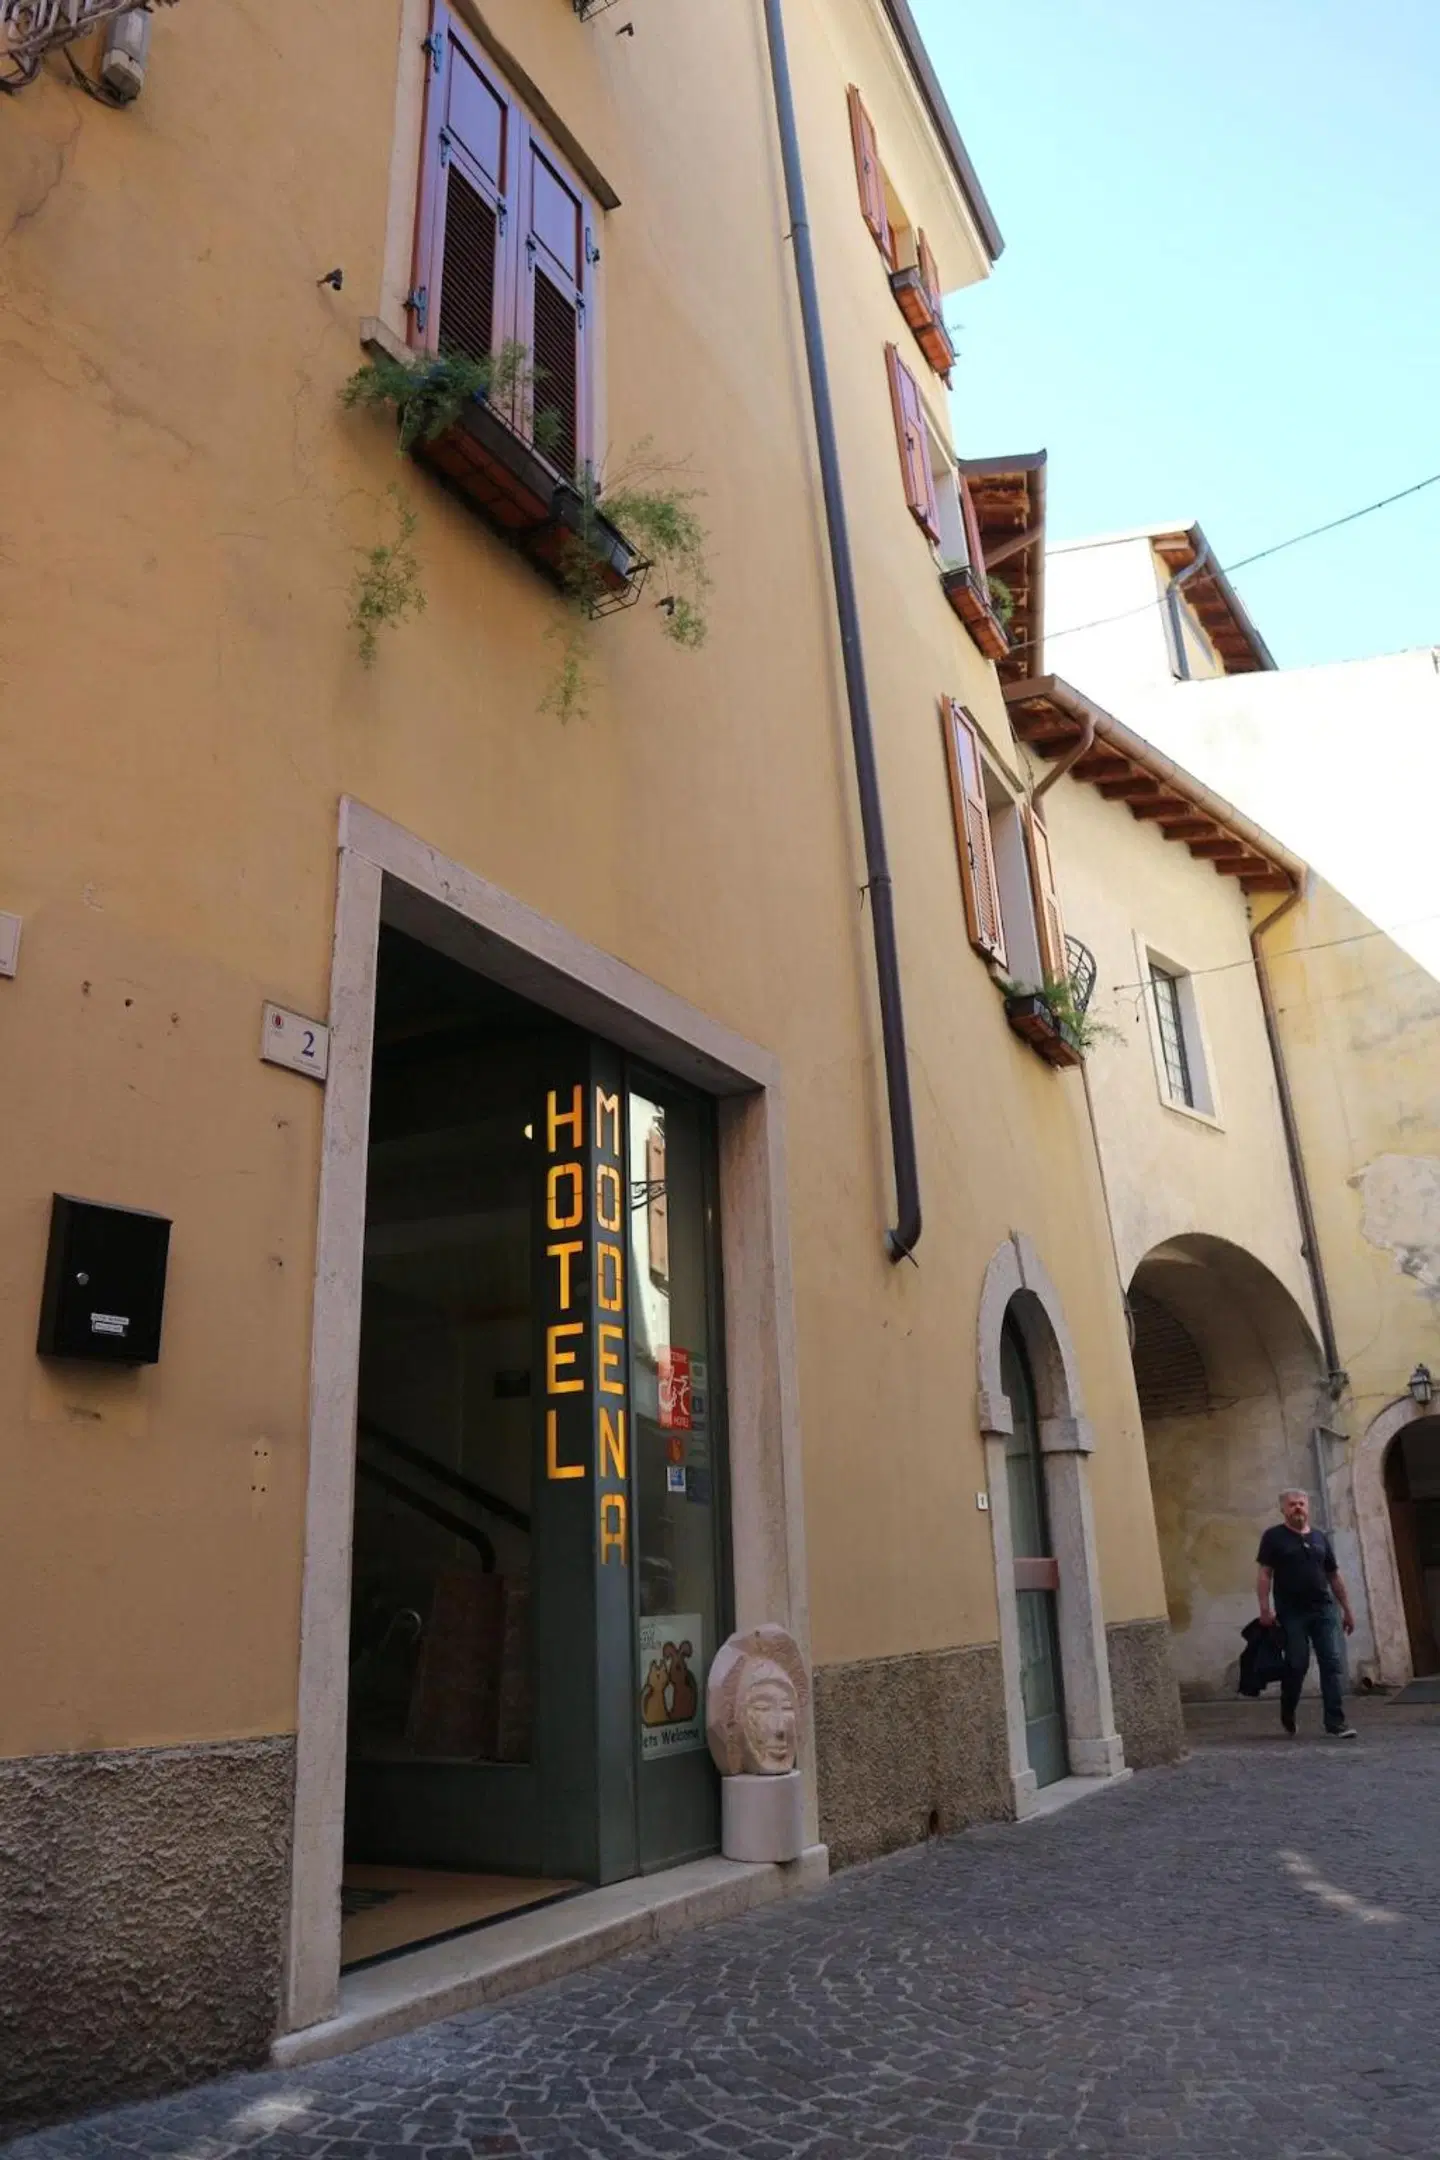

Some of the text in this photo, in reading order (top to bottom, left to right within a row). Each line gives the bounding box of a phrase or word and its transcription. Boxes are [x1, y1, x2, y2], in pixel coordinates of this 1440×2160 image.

[301, 1030, 315, 1058] 2
[546, 1083, 585, 1480] HOTEL
[595, 1084, 628, 1566] MODENA
